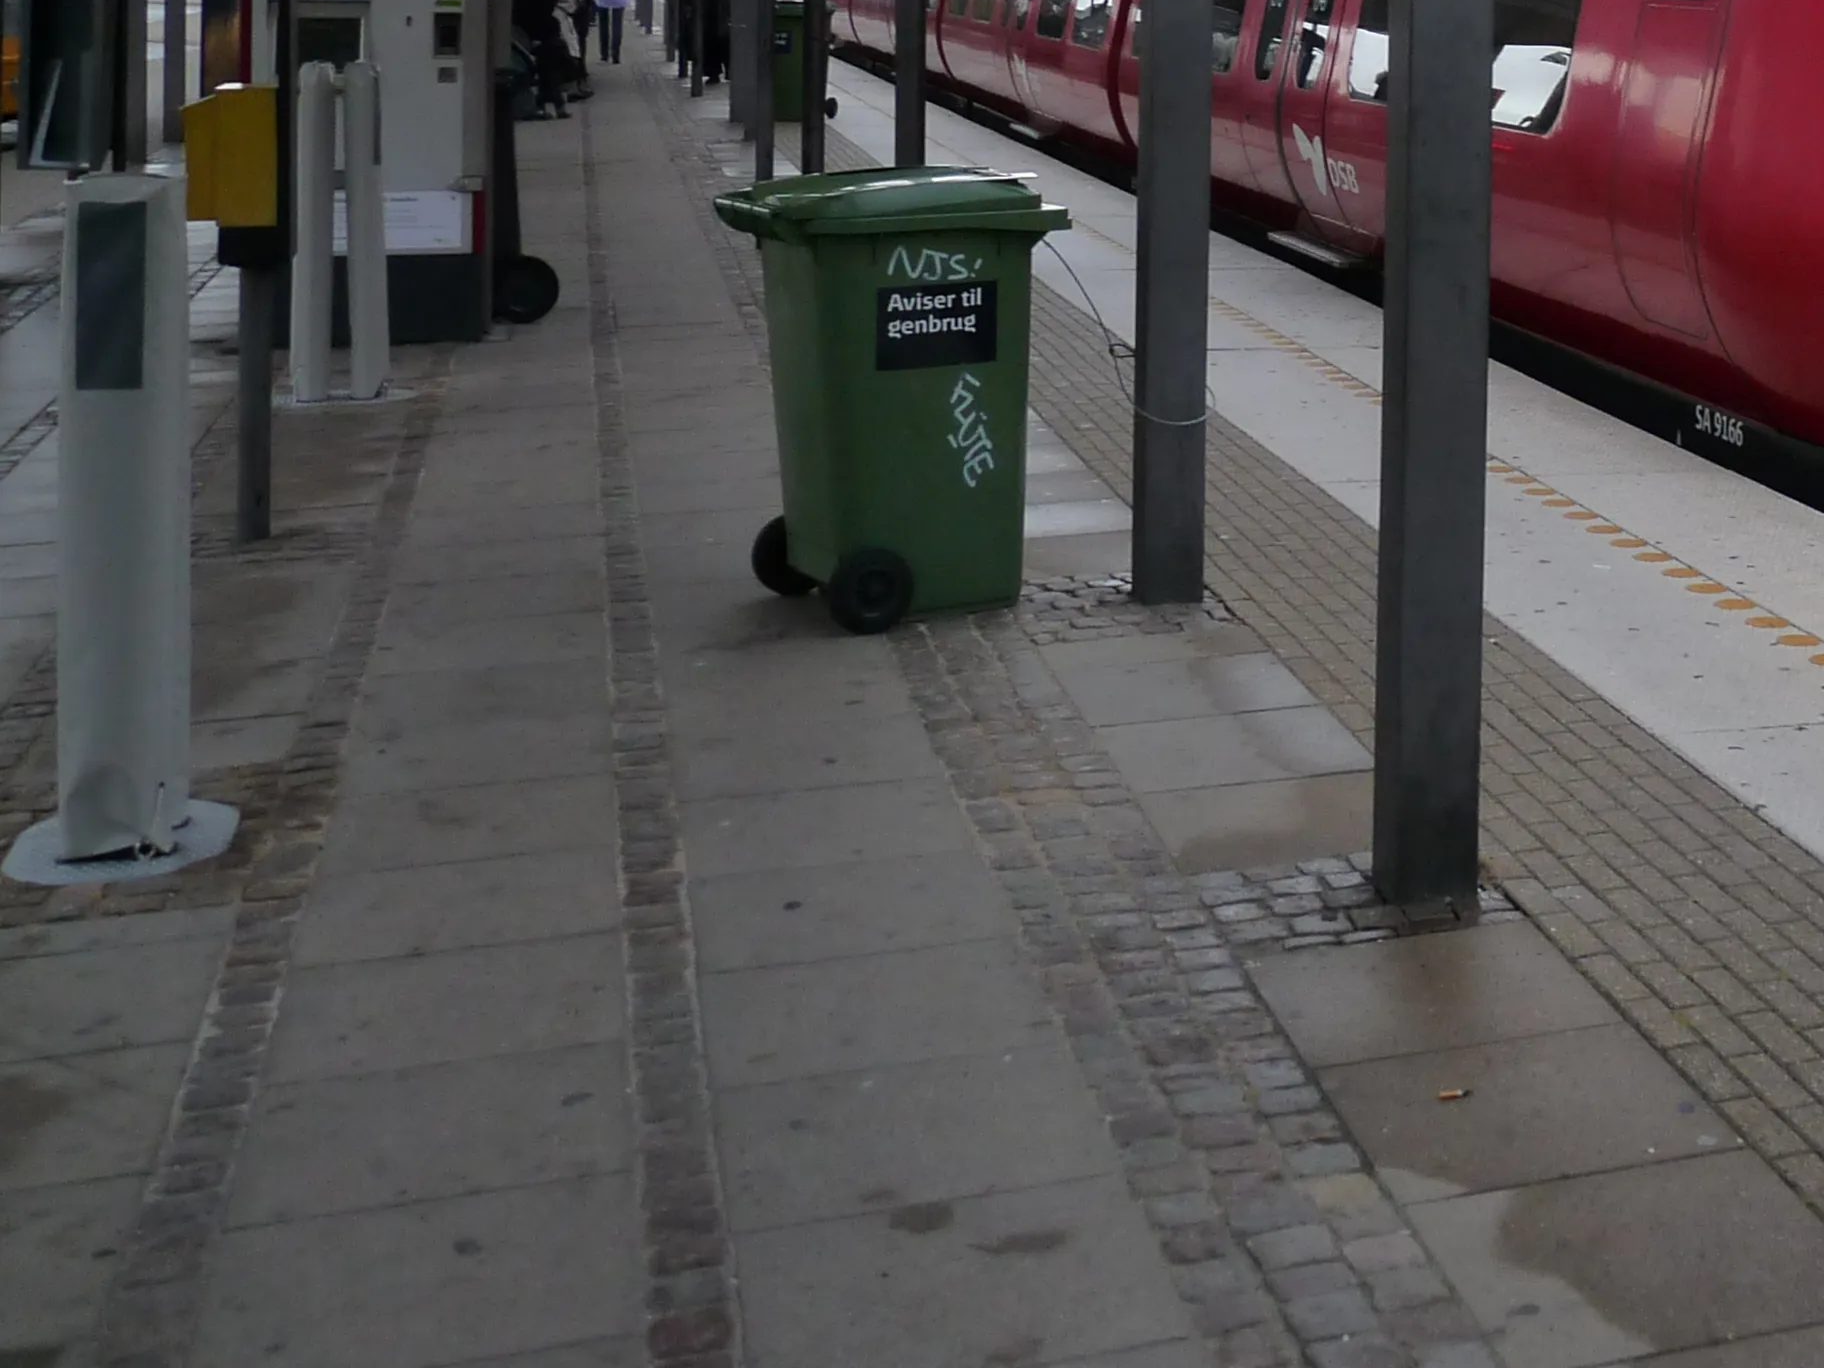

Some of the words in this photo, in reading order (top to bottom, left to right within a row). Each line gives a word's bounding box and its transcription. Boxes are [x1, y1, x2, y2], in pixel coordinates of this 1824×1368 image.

[1327, 157, 1360, 194] DSB
[887, 292, 957, 312] Aviser
[961, 287, 982, 307] til
[887, 314, 977, 339] genbrug
[1695, 404, 1711, 434] SA
[1713, 412, 1744, 447] 9166
